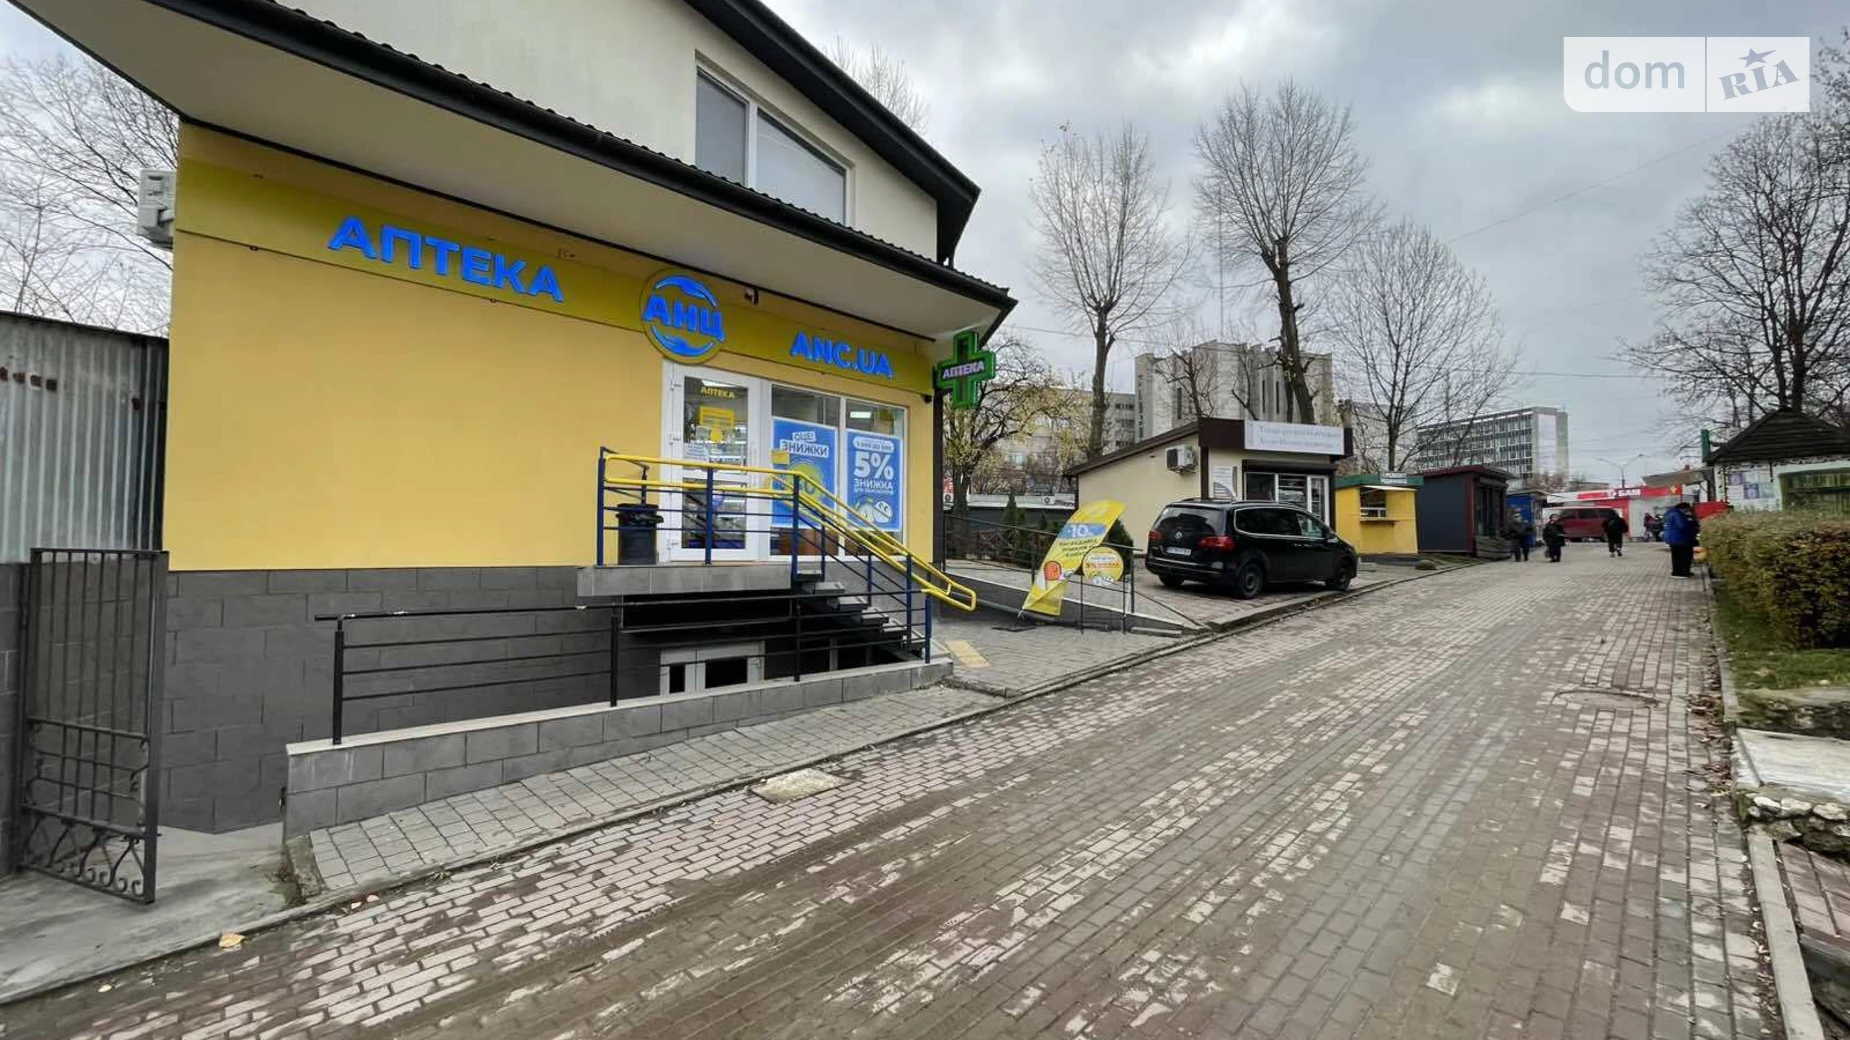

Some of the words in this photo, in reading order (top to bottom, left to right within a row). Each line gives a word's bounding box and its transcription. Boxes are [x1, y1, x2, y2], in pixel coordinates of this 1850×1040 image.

[327, 215, 565, 303] АПТЕКА
[643, 294, 726, 343] АНЦ
[790, 330, 894, 378] ANC.UA
[943, 361, 985, 380] АПТЕКА
[700, 386, 736, 399] АПТЕКА
[781, 440, 828, 457] ЗНИЖКИ
[853, 451, 895, 480] 5%
[853, 478, 894, 491] ЗНИЖКА
